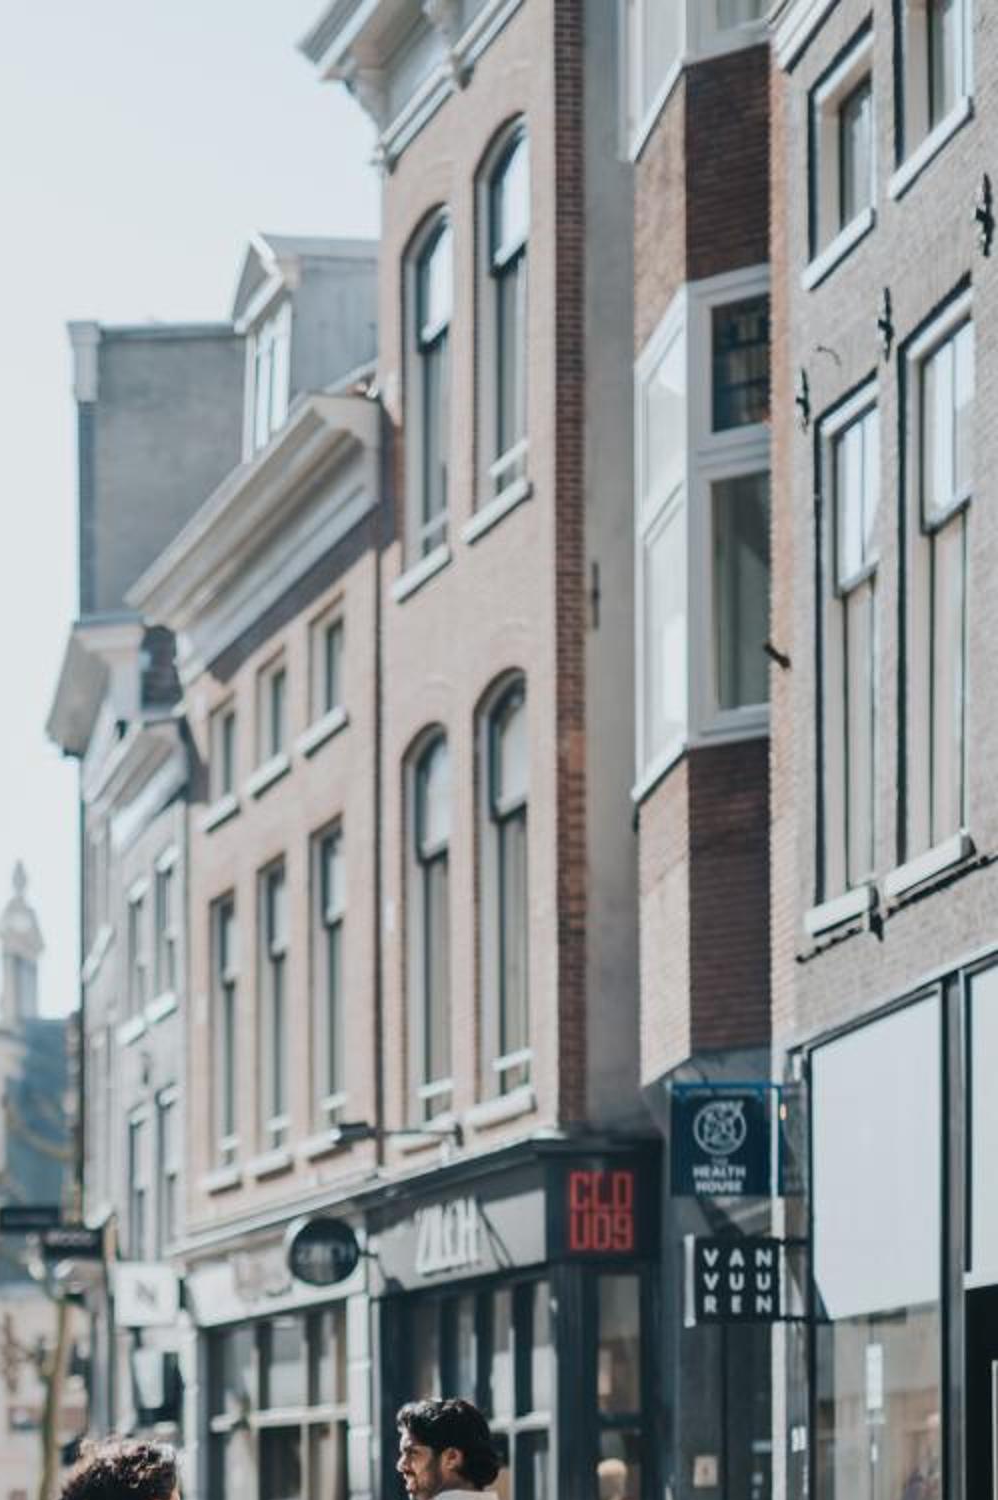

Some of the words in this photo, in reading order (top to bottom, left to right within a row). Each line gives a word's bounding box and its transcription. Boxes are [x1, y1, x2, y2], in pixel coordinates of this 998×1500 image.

[692, 1164, 746, 1178] HEALTH
[695, 1180, 742, 1193] HOUSE
[703, 1247, 773, 1268] VAN
[703, 1272, 773, 1292] VUU
